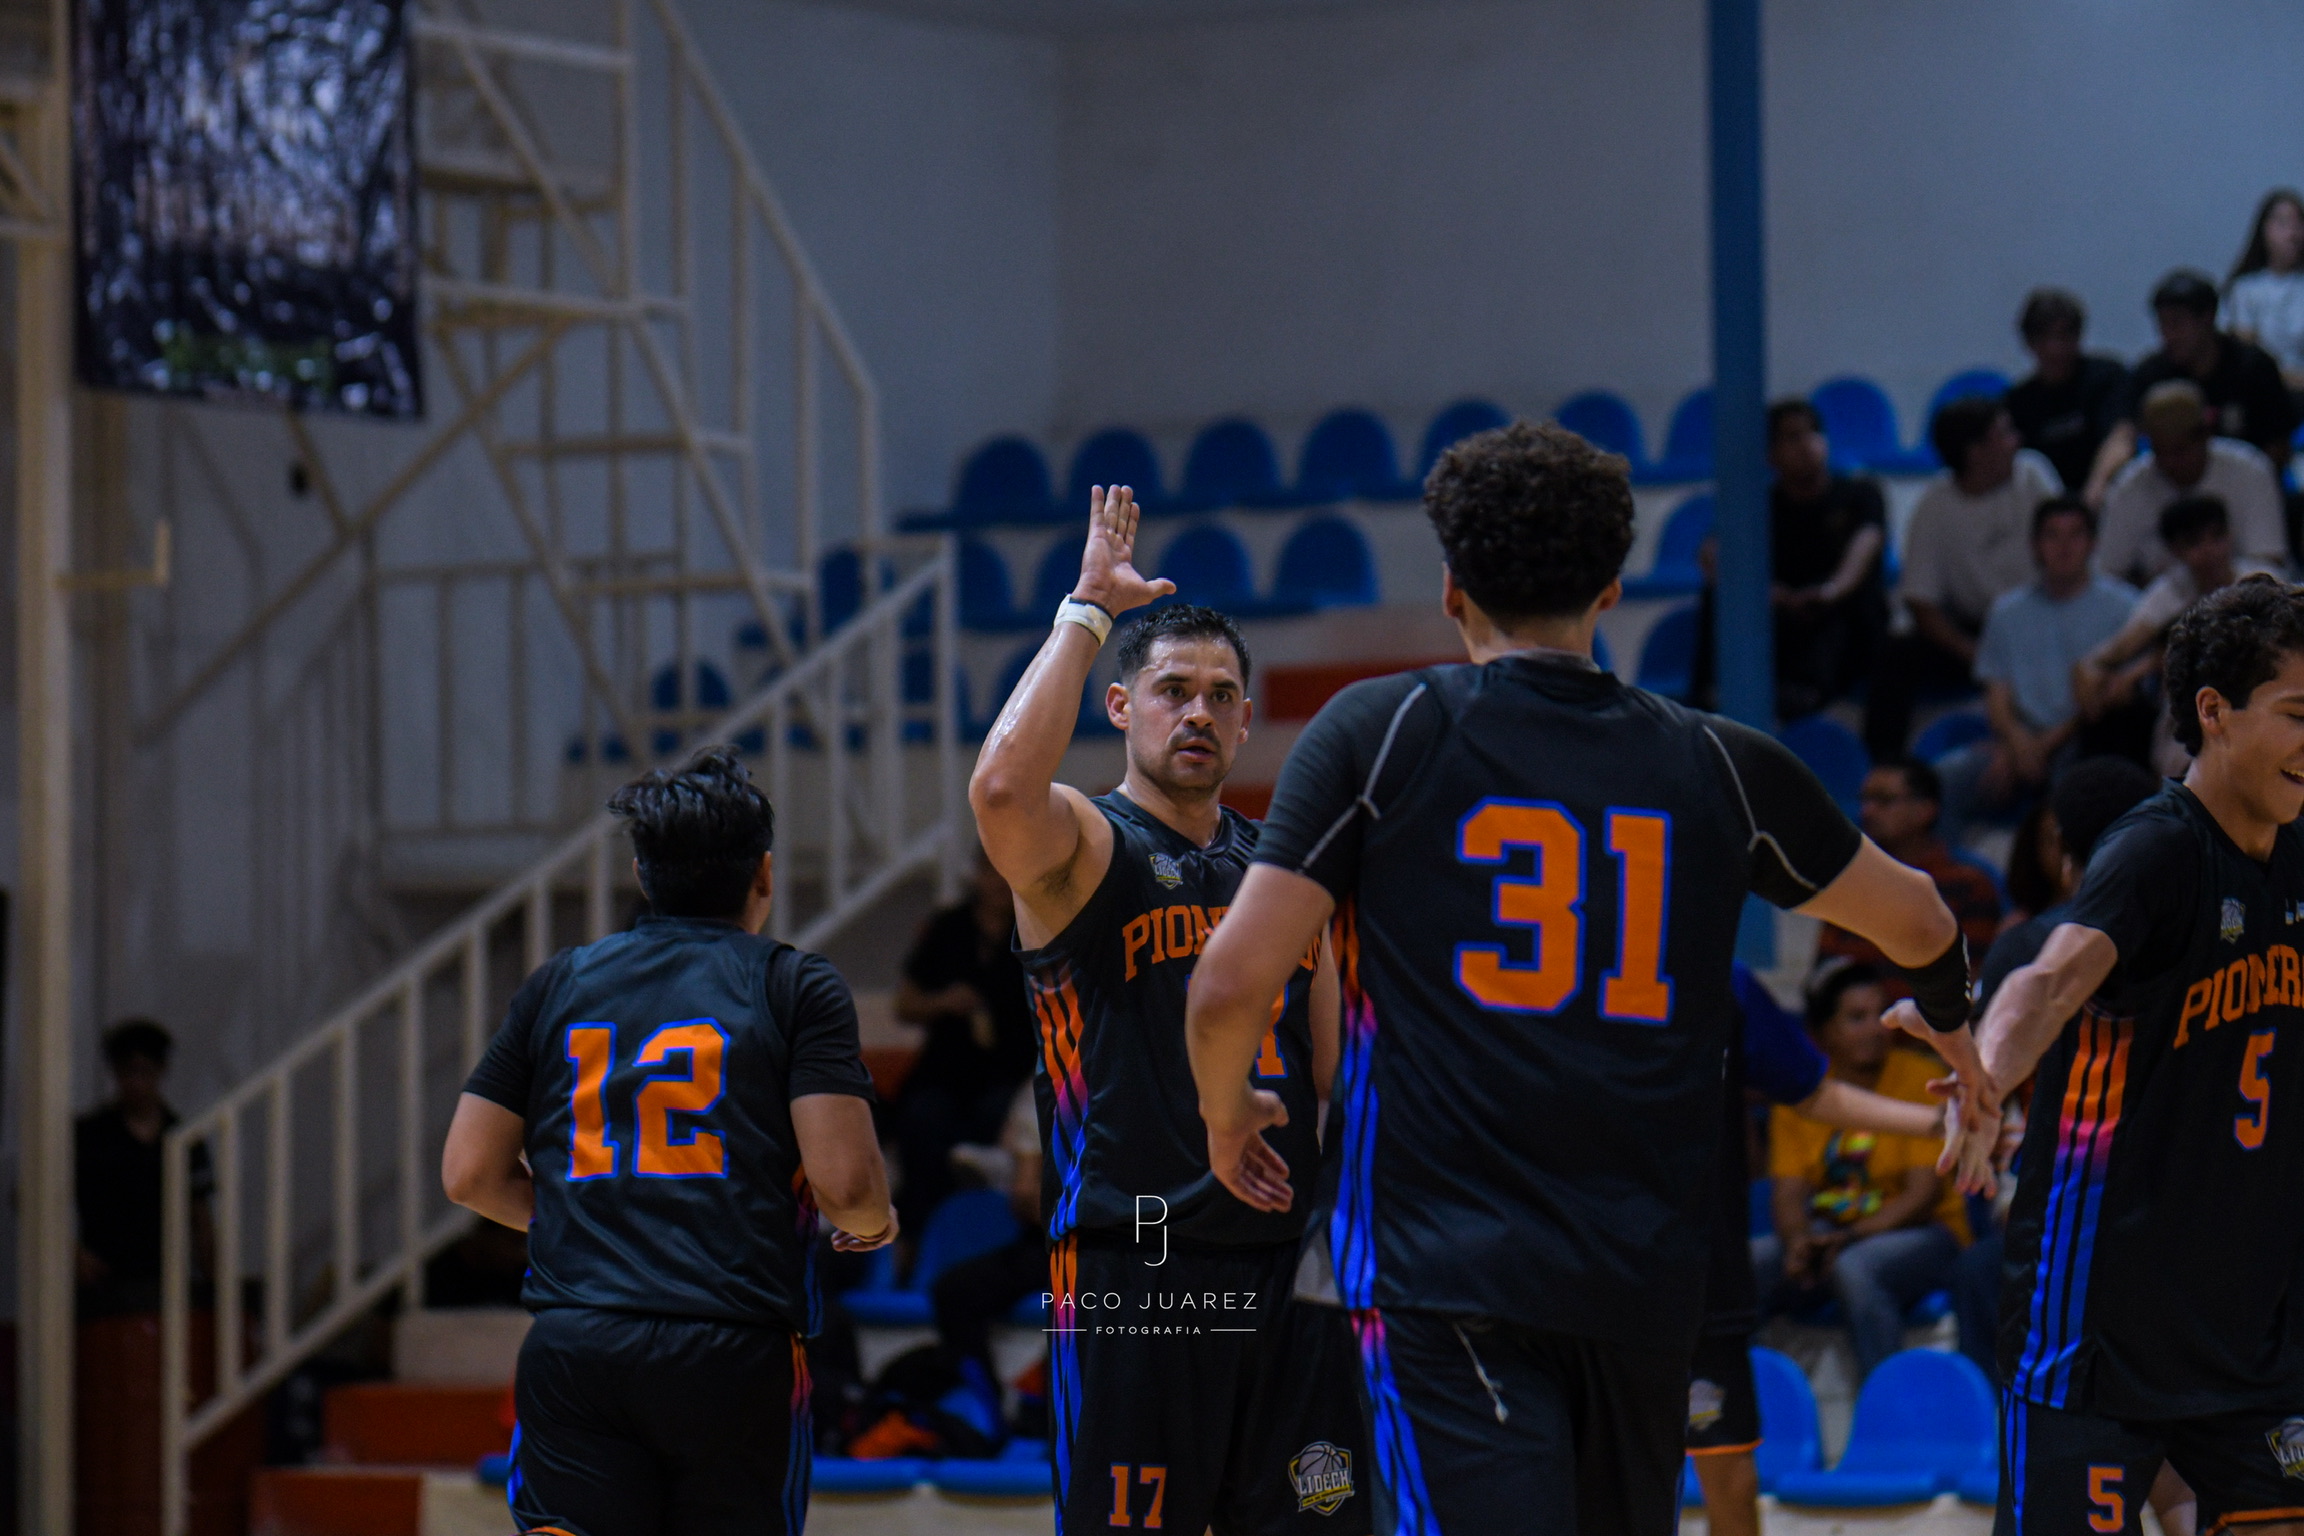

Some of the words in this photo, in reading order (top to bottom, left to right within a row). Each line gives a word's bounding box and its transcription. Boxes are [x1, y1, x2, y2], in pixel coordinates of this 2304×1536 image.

[1453, 795, 1674, 1027] 31
[2173, 944, 2304, 1050] PIONER
[564, 1017, 731, 1182] 12
[2234, 1027, 2277, 1151] 5
[1108, 1462, 1168, 1529] 17
[1298, 1470, 1349, 1494] LIDECH
[2087, 1462, 2126, 1533] 5
